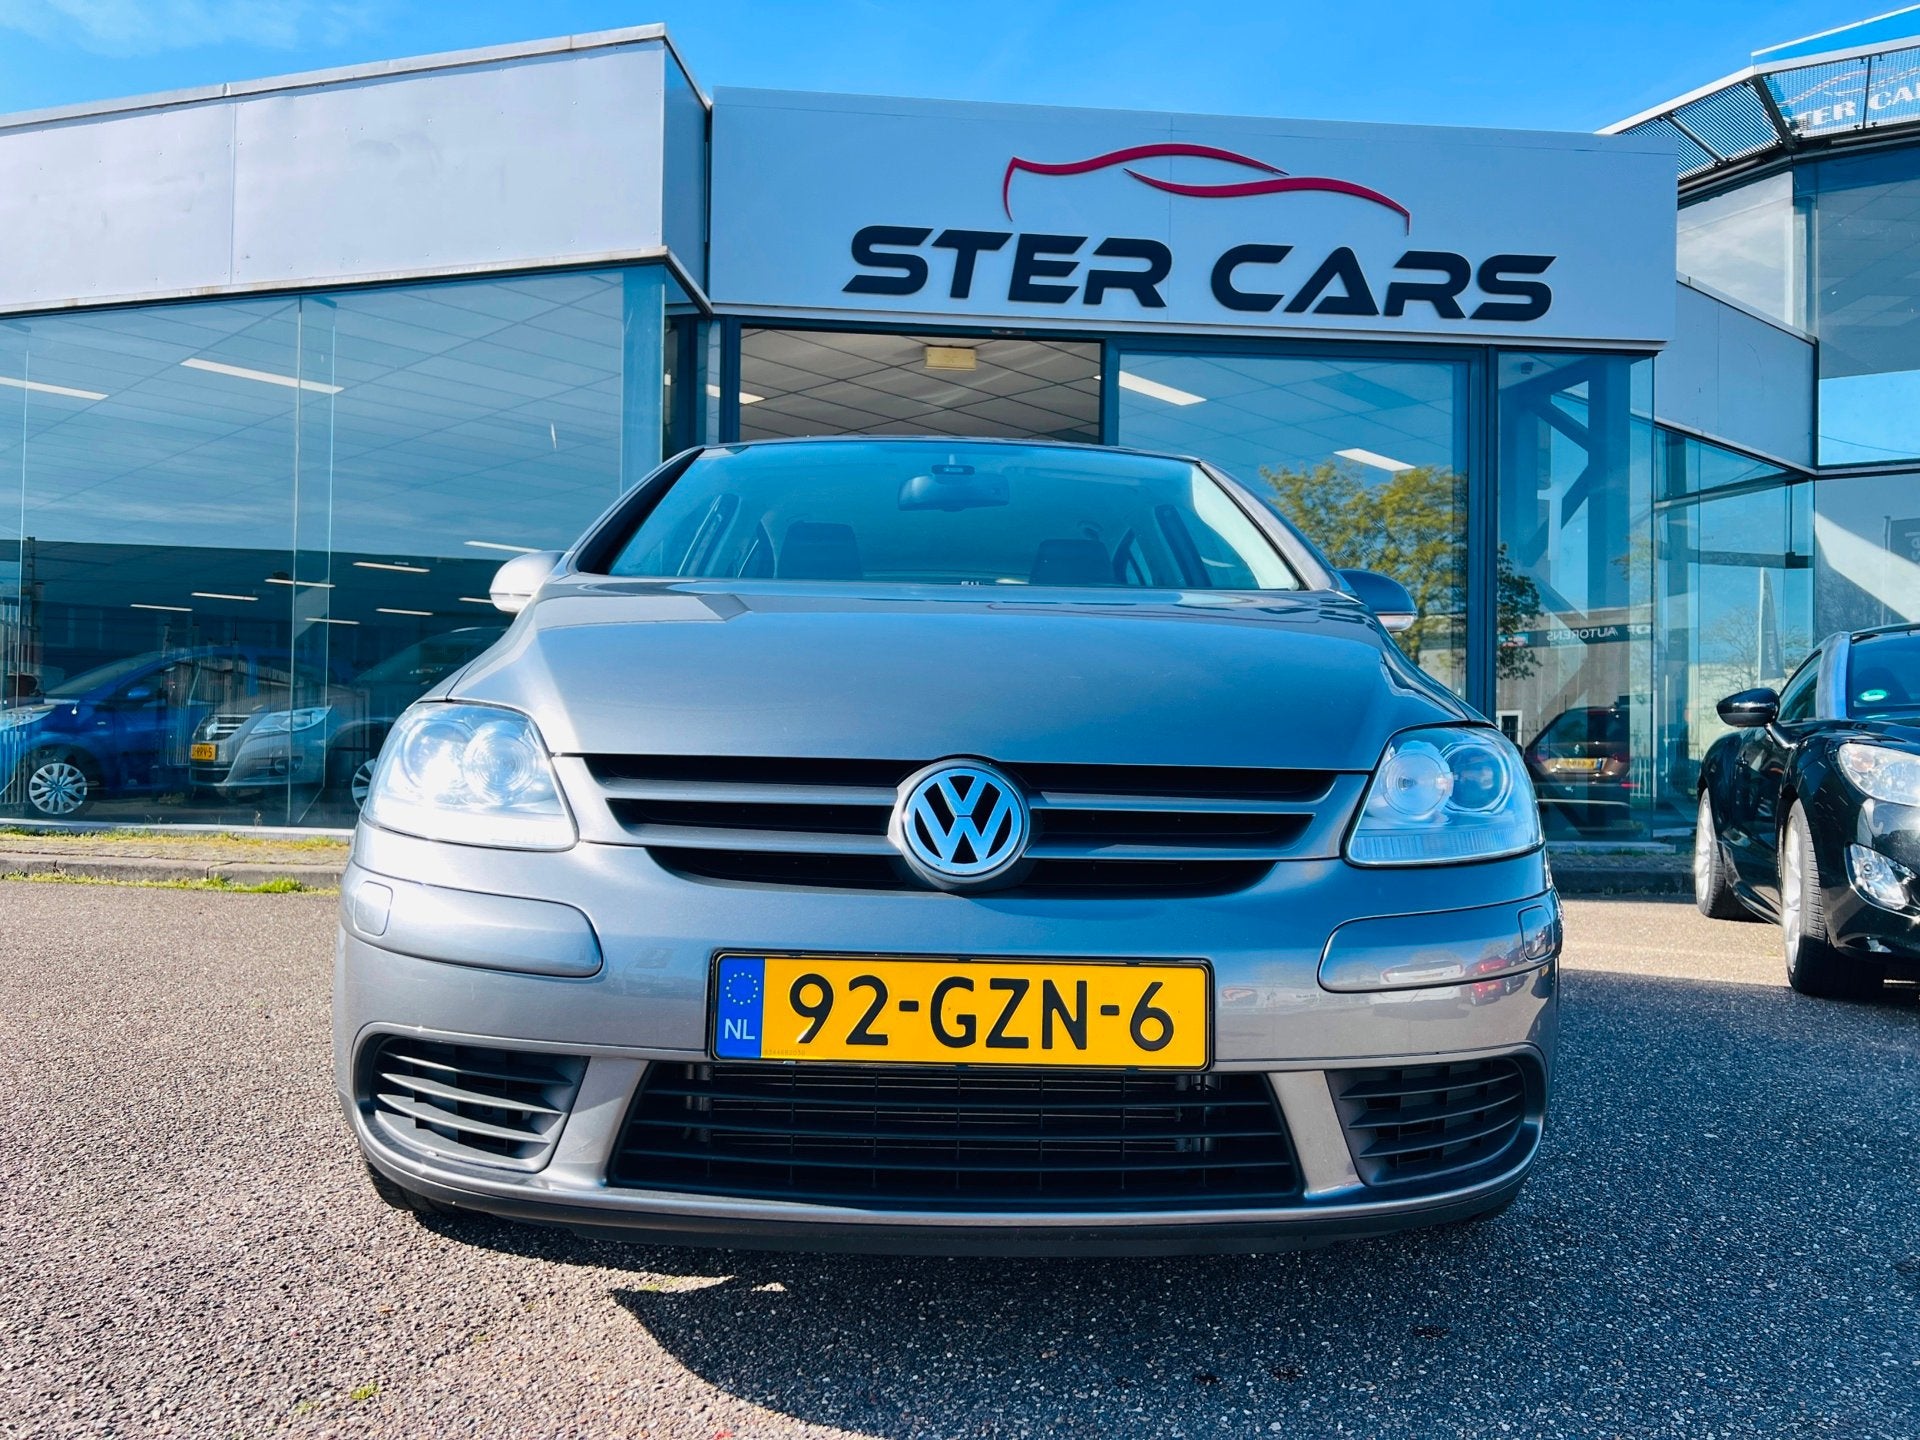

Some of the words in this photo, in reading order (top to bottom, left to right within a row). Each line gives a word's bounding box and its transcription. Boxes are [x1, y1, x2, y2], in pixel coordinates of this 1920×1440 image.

[1868, 82, 1920, 110] CA
[842, 224, 1173, 308] STER
[1210, 243, 1557, 322] CARS
[724, 1018, 756, 1040] NL
[788, 972, 1174, 1052] 92-GZN-6
